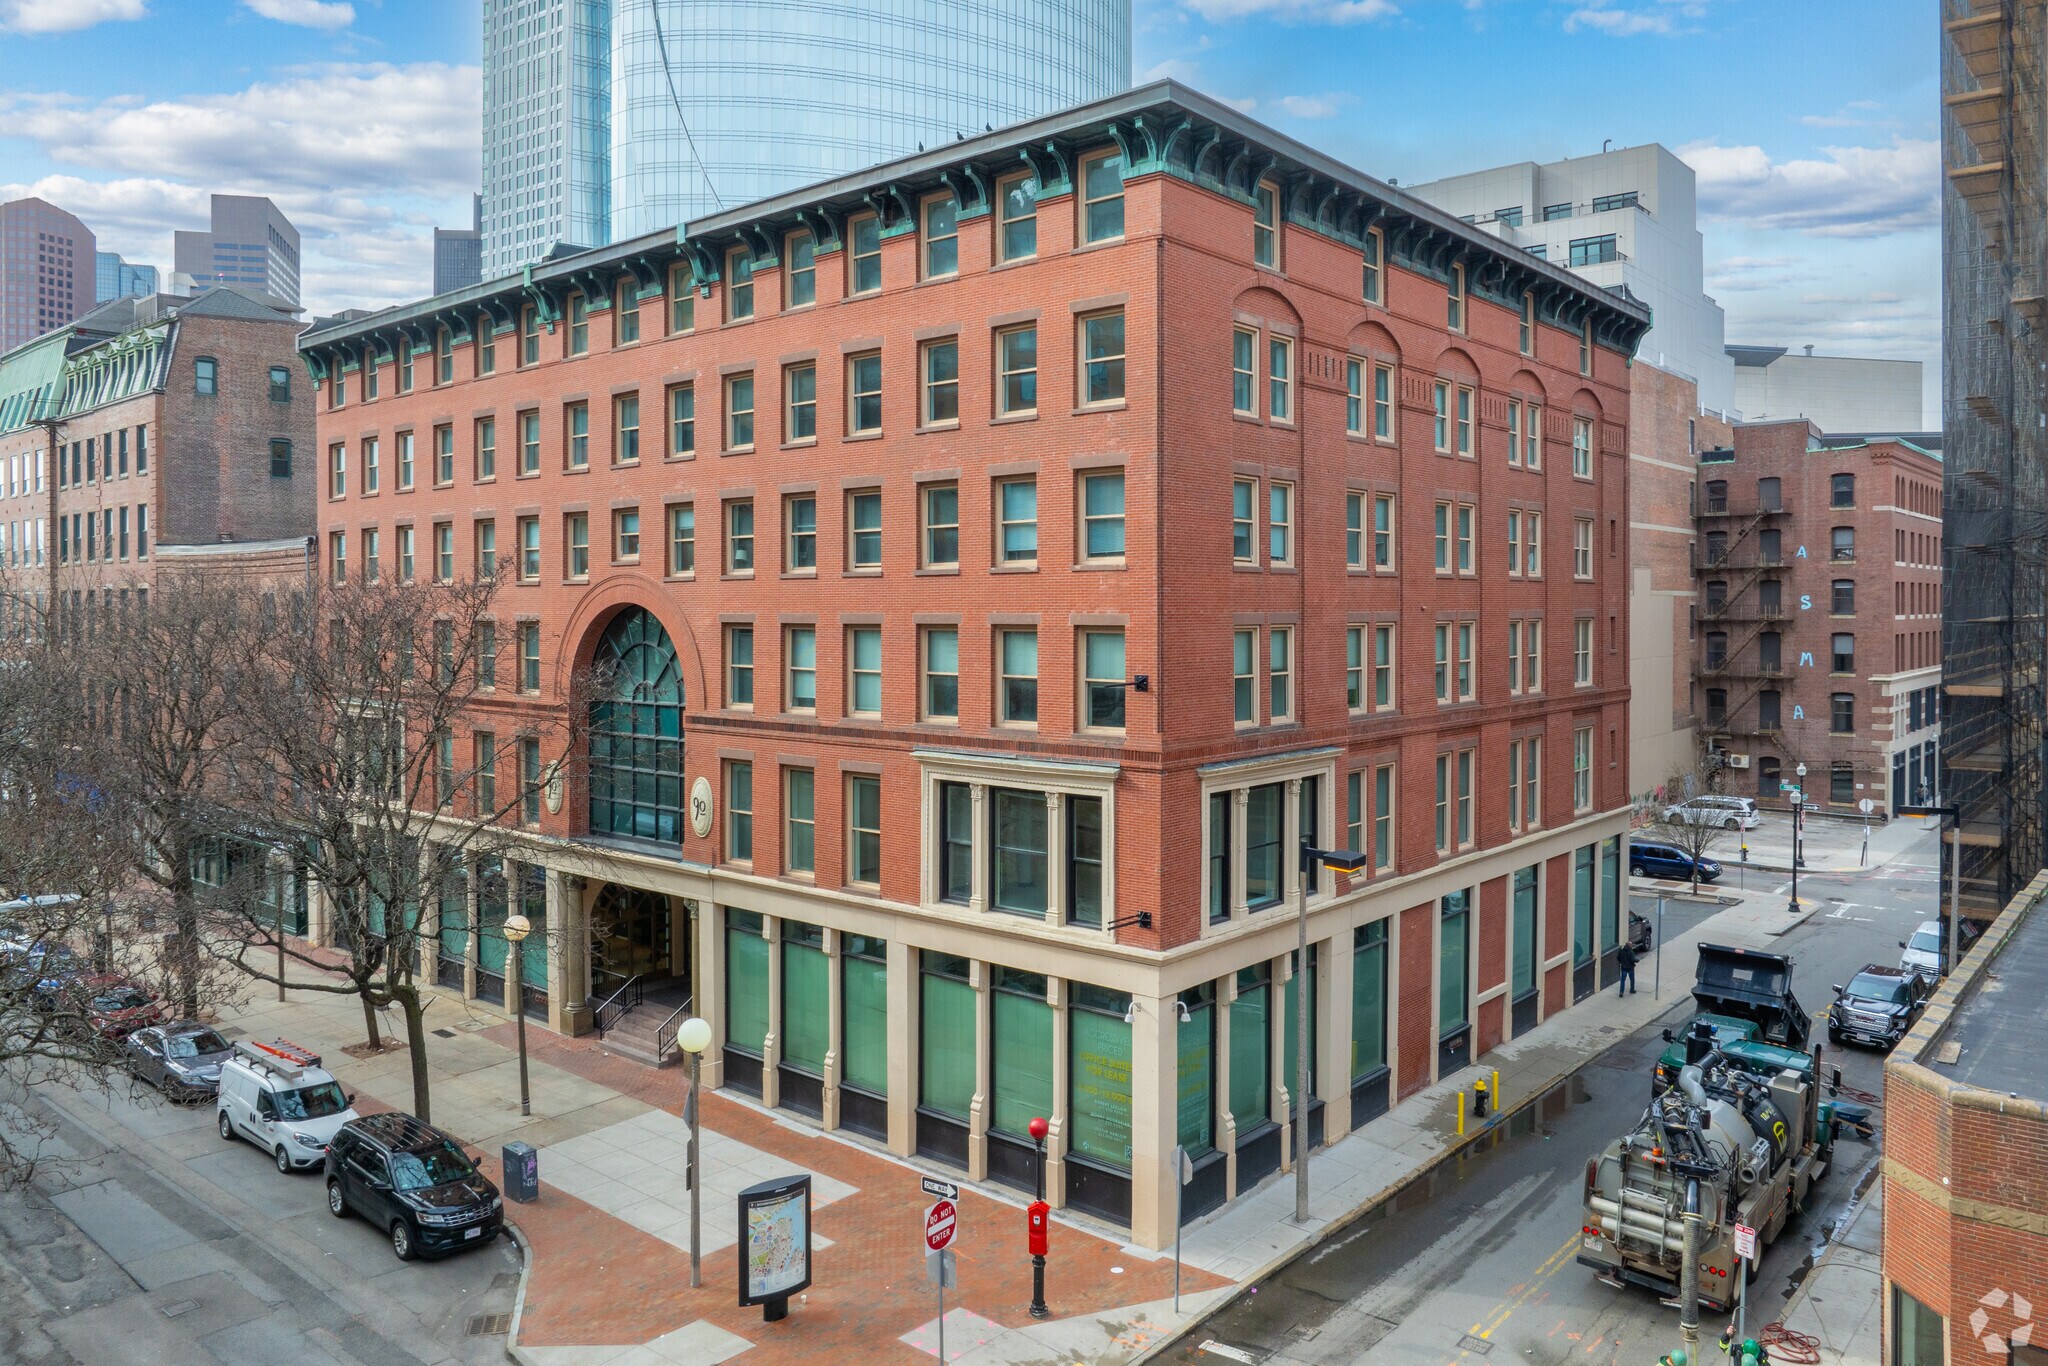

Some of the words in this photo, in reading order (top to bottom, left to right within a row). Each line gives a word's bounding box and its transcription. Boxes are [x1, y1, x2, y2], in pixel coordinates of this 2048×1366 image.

[693, 797, 706, 821] 90
[1104, 1069, 1128, 1083] LEASE
[925, 1181, 936, 1190] ONE
[938, 1184, 948, 1193] WAY
[930, 1213, 938, 1225] DO
[940, 1205, 952, 1219] NOT
[932, 1228, 951, 1244] ENTER
